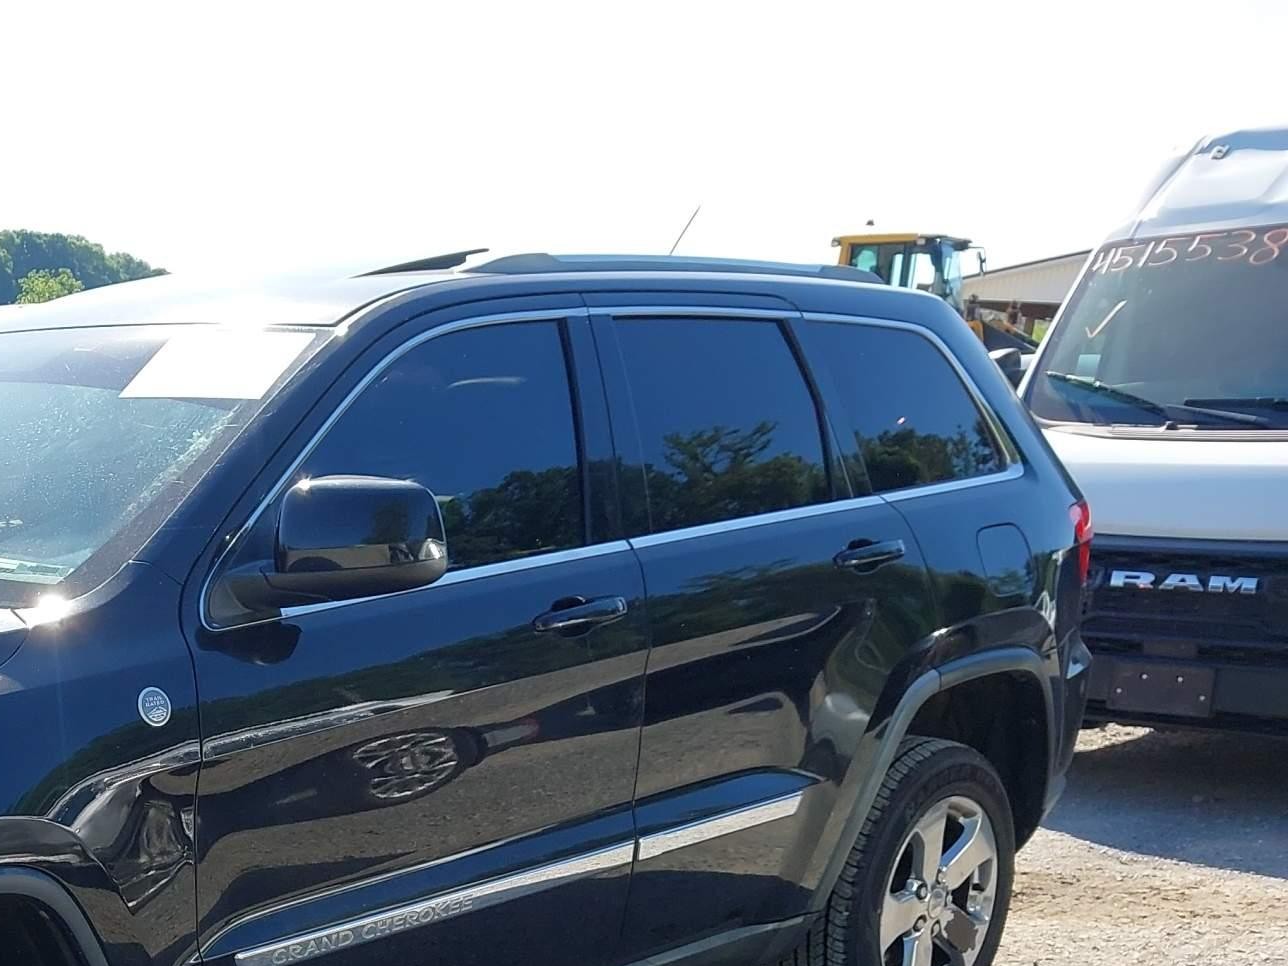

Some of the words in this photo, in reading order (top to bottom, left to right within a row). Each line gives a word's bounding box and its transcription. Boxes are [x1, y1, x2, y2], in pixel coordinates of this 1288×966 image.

[1109, 569, 1260, 595] RAM
[271, 929, 355, 965] GRAND
[361, 894, 474, 940] CHEROKEE
